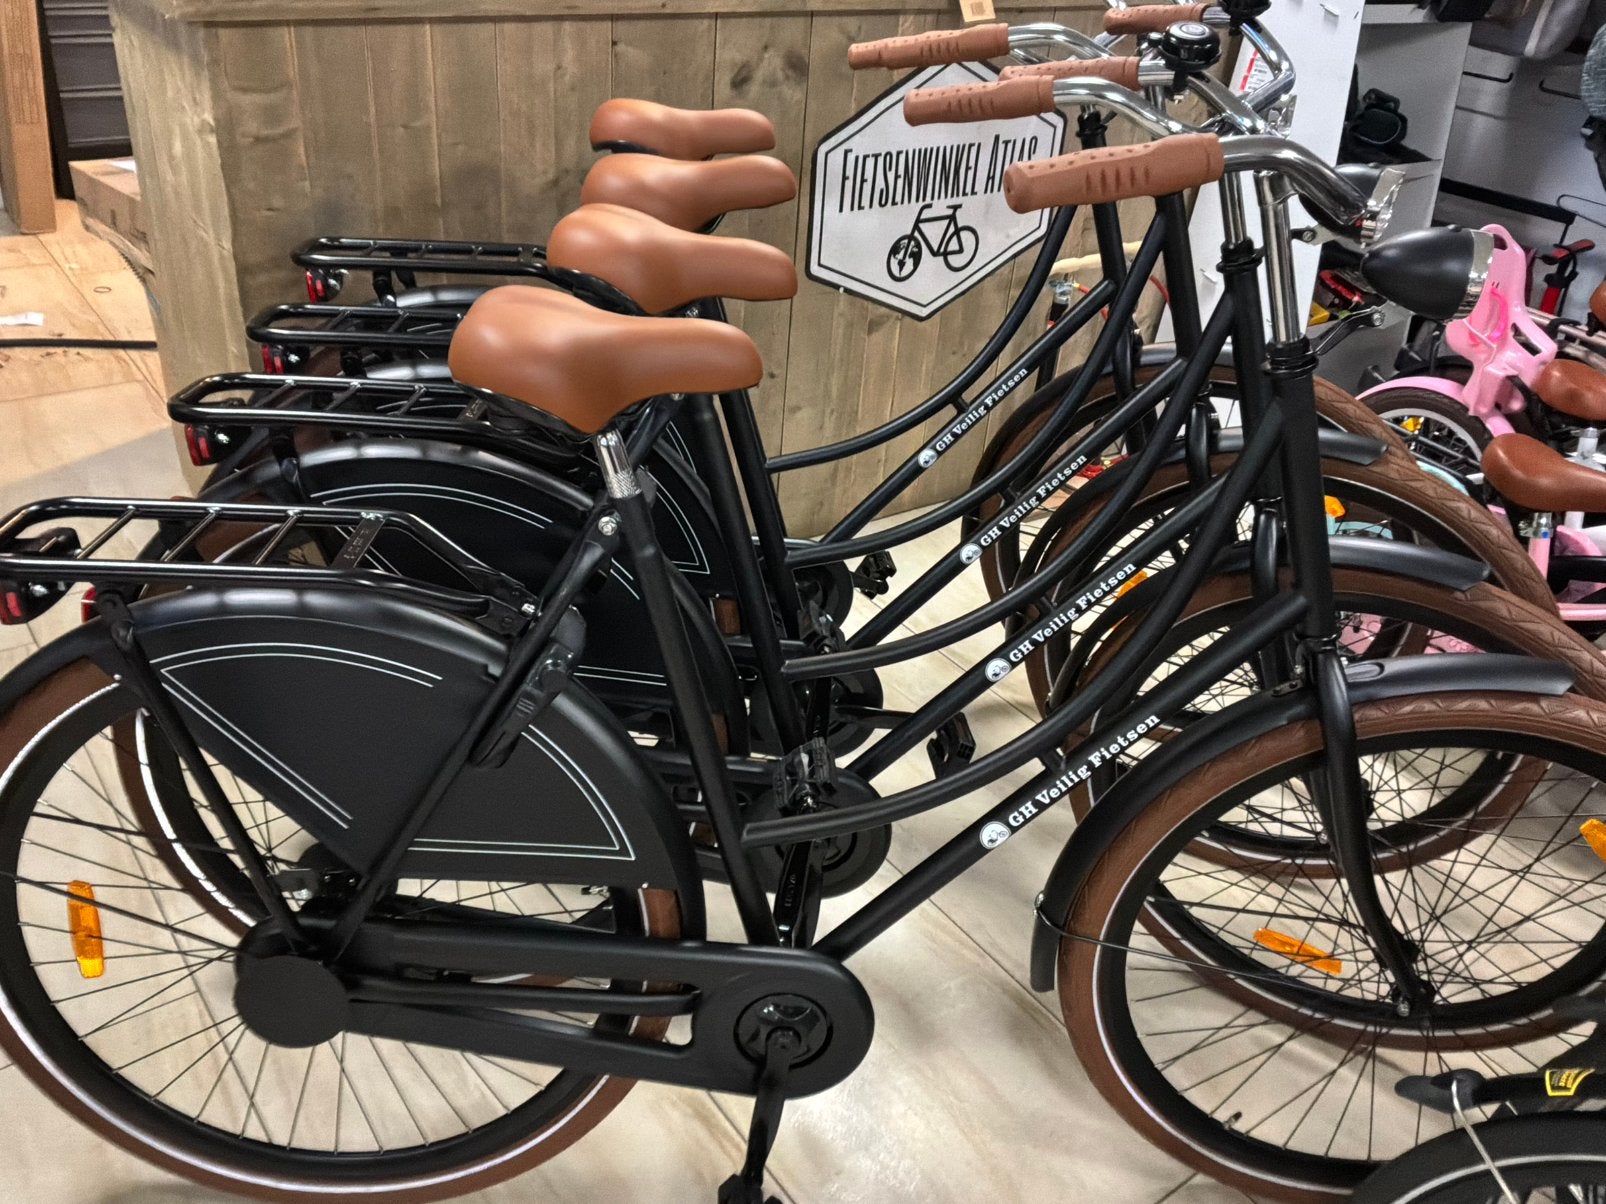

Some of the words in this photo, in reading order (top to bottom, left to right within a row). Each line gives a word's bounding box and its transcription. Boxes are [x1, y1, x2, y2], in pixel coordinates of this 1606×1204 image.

[838, 142, 982, 213] FIETSENWINKEL
[936, 435, 954, 452] GH
[952, 406, 987, 436] Veilig
[984, 368, 1028, 408] Fietsen
[979, 527, 1003, 548] GH
[1000, 498, 1040, 528] Veilig
[1036, 454, 1088, 500] Fietsen
[1008, 643, 1035, 663] GH
[1032, 608, 1078, 644] Veilig
[1075, 563, 1137, 607] Fietsen
[1008, 803, 1039, 828] GH
[1035, 765, 1092, 804] Veilig
[1088, 714, 1161, 767] Fietsen
